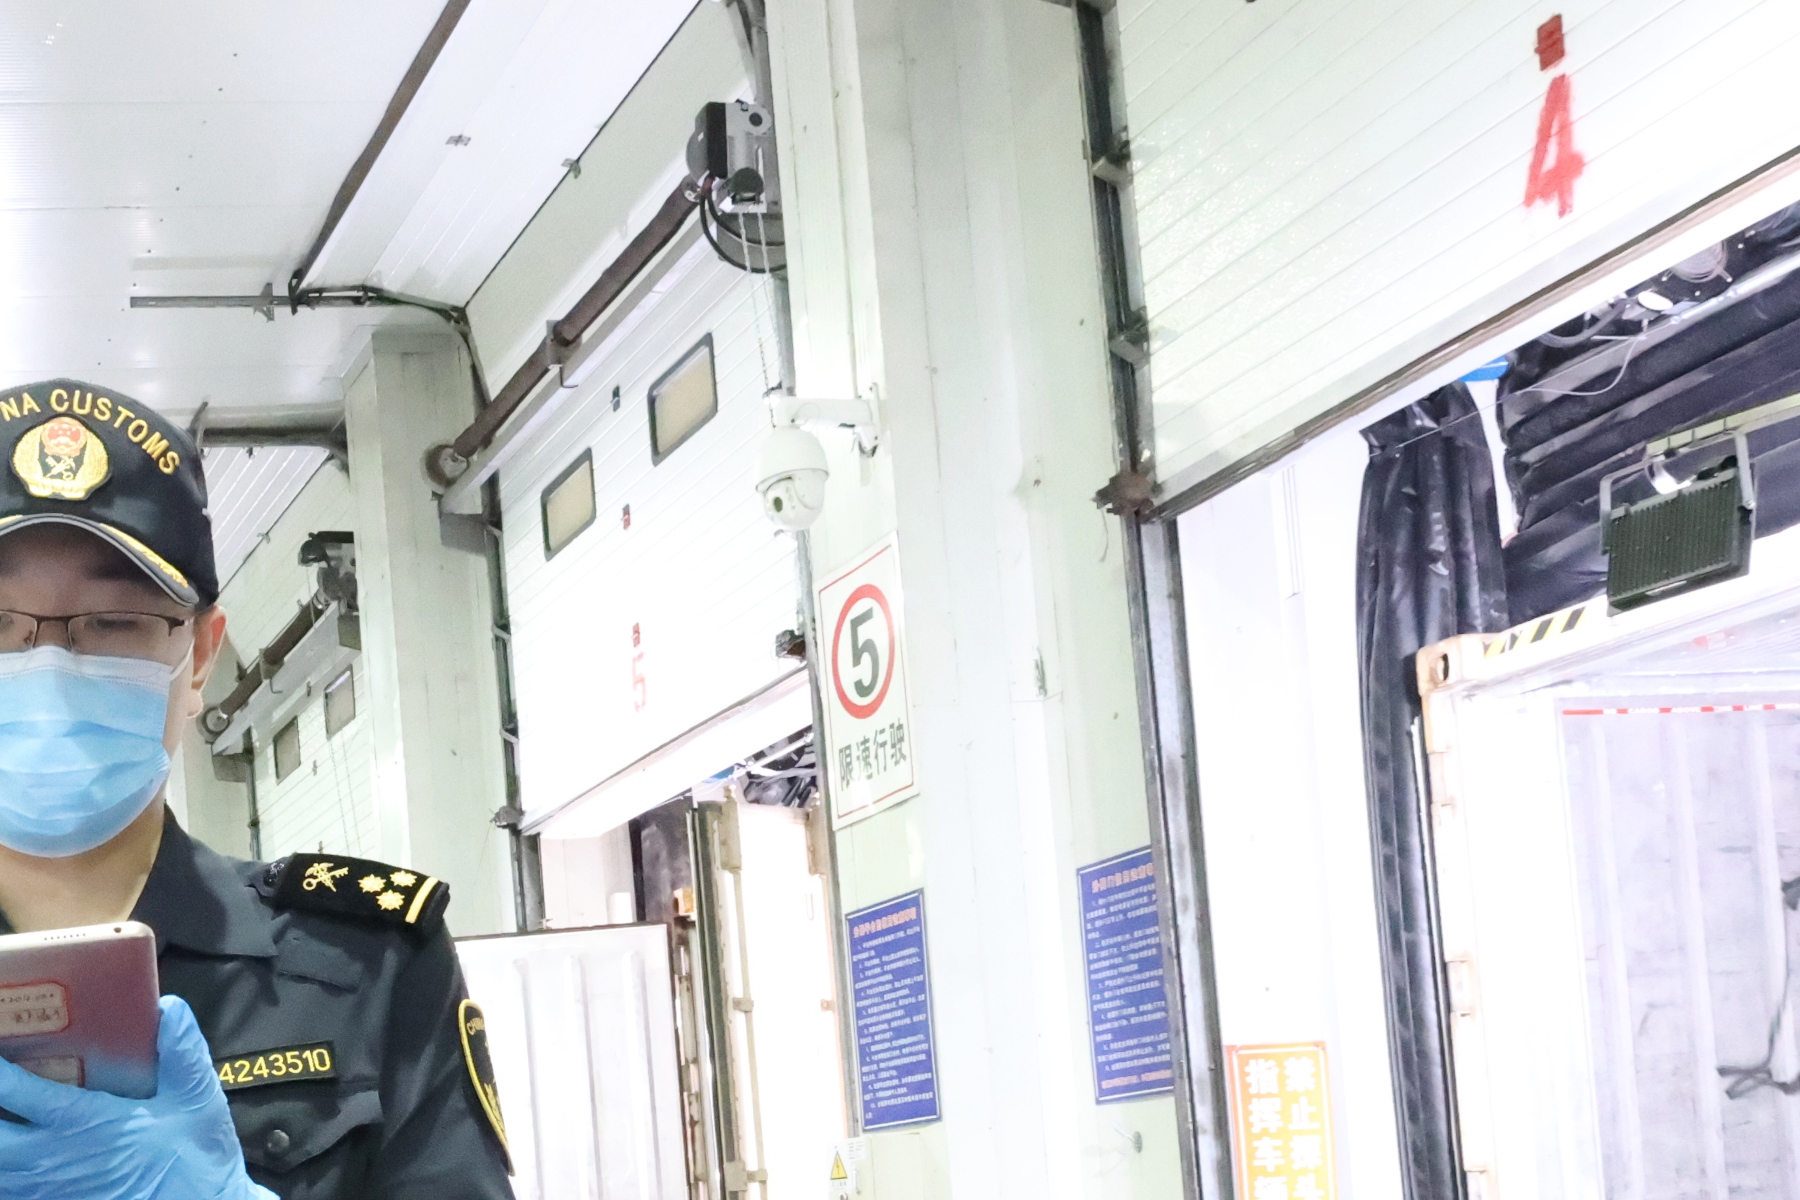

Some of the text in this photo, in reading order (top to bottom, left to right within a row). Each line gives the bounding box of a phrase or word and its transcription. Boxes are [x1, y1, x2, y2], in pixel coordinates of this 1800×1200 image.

[1524, 73, 1585, 219] 4
[50, 388, 181, 475] CUSTOMS
[849, 606, 880, 699] 5
[838, 718, 908, 792] 限速行驶
[219, 1048, 331, 1084] 4243510
